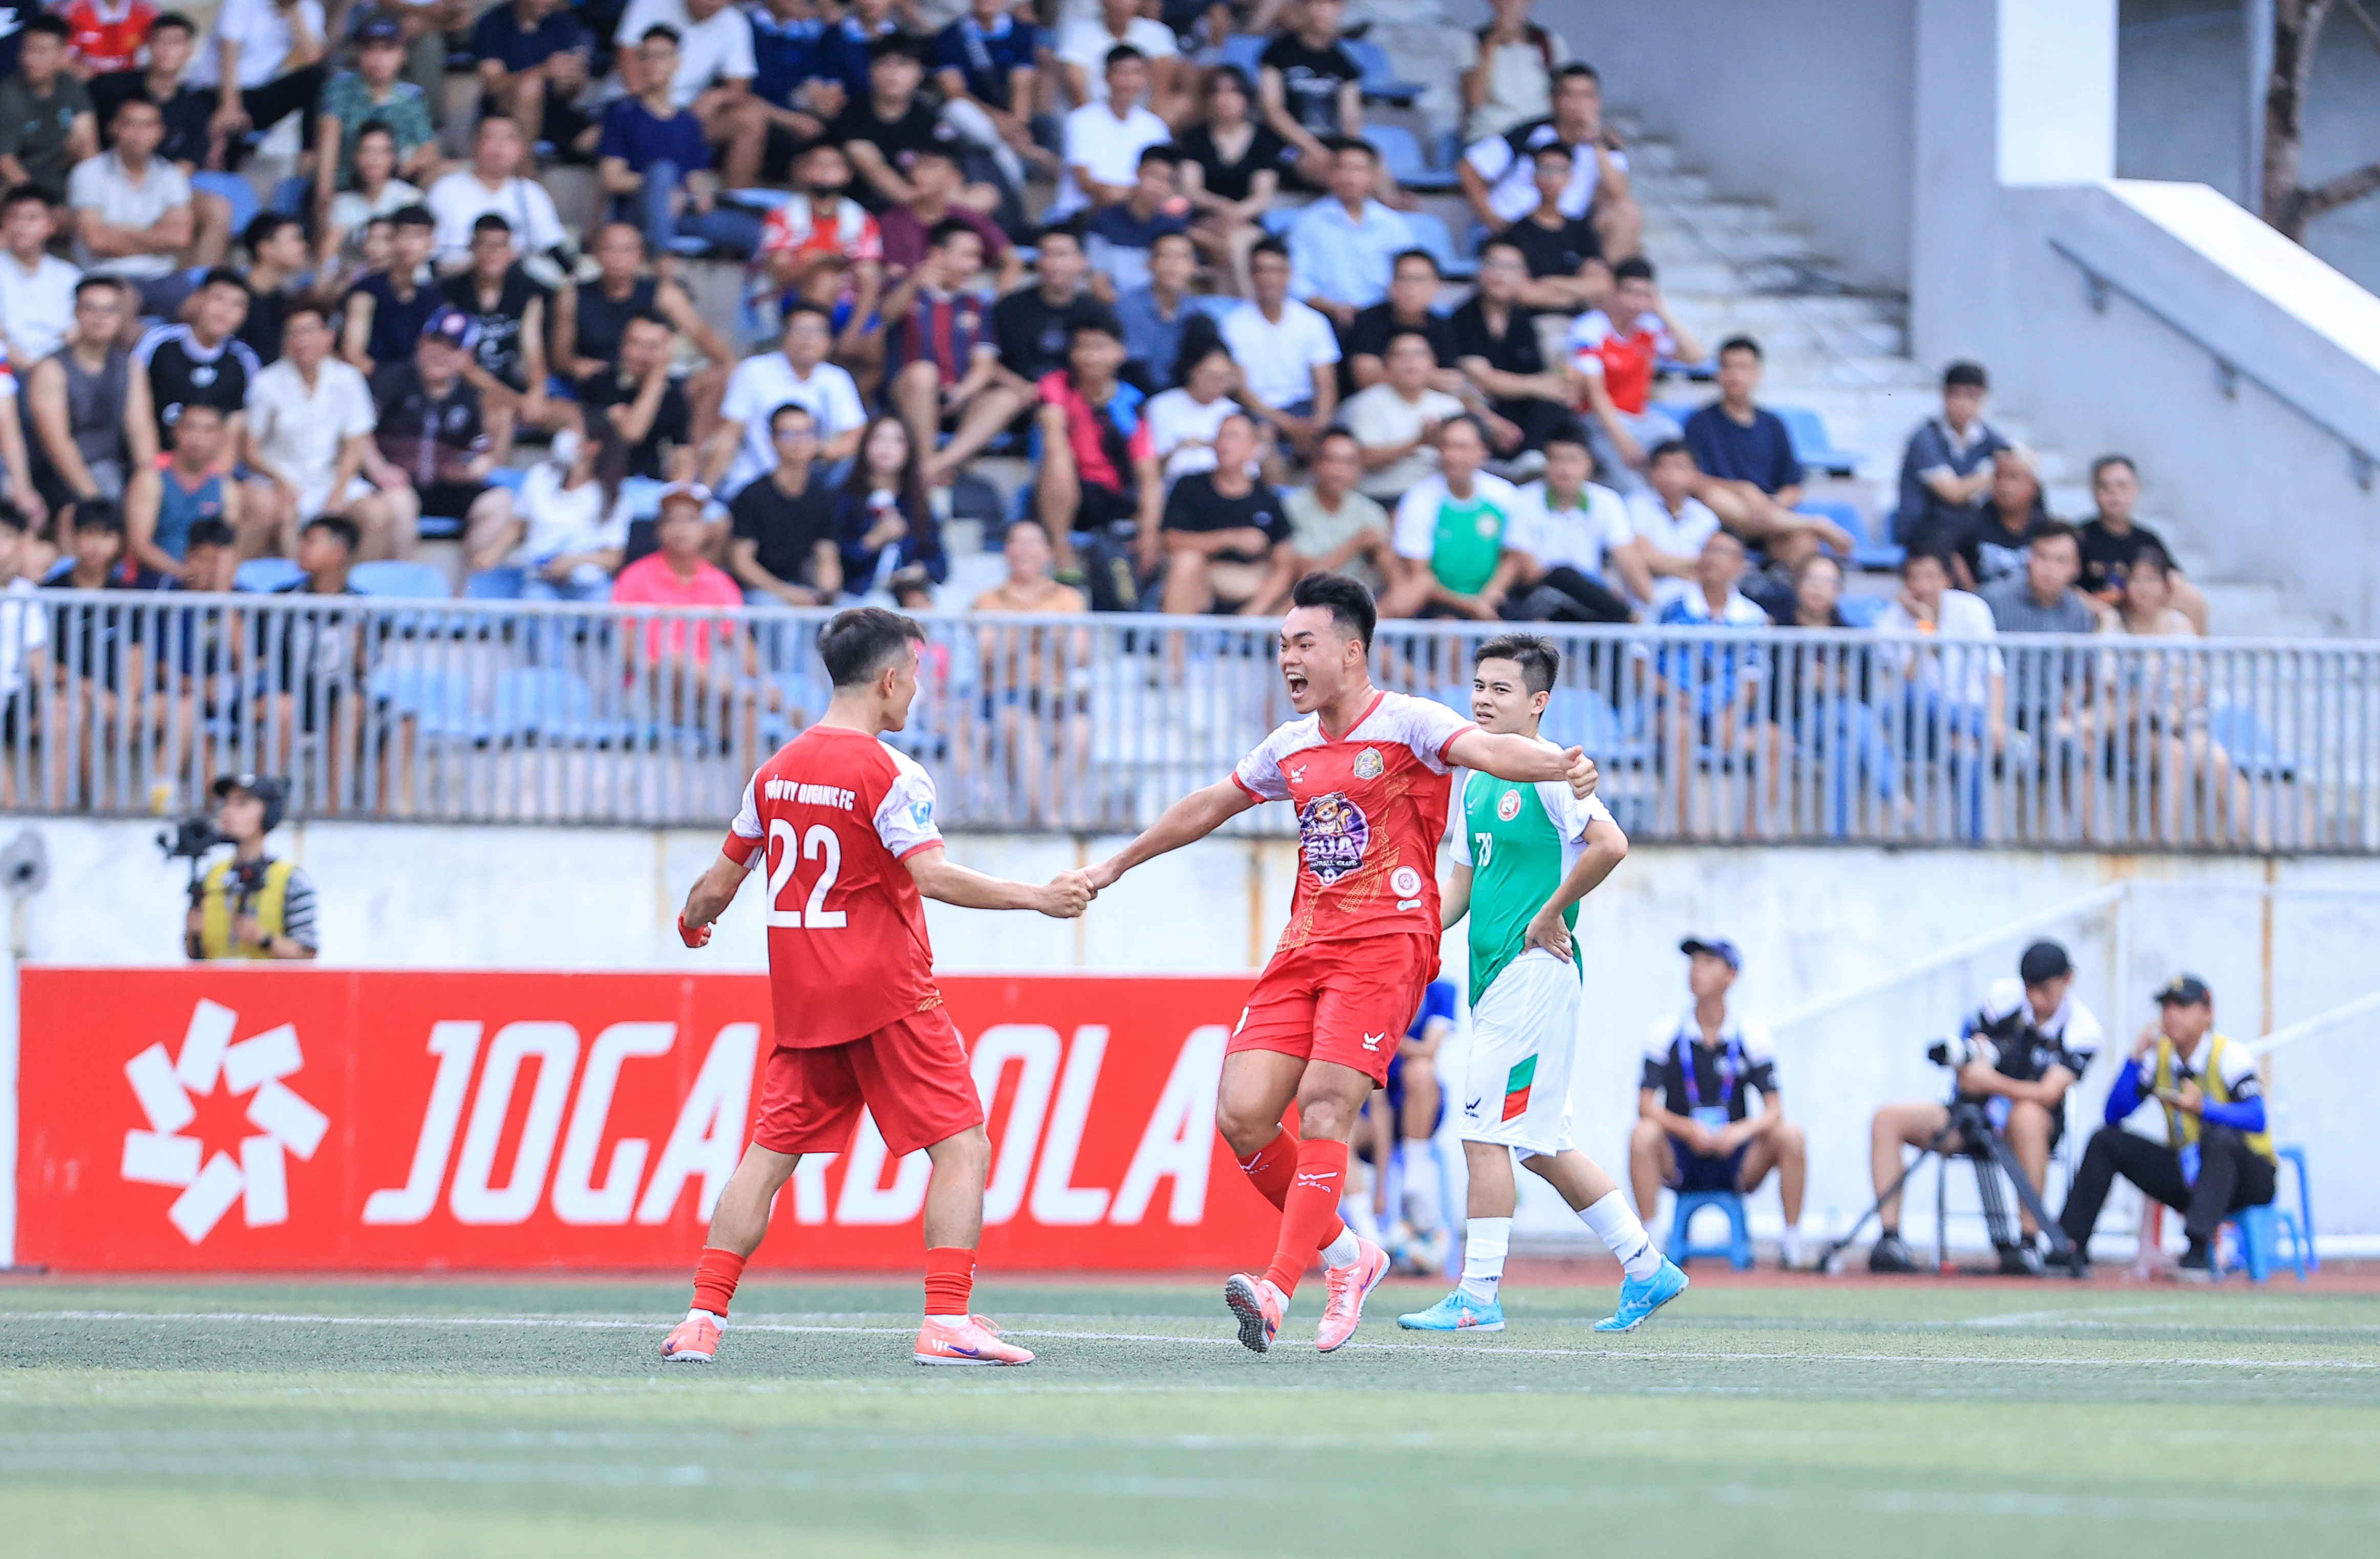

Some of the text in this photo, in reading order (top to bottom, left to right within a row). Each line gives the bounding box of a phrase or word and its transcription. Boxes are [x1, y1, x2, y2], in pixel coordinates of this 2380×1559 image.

[838, 789, 855, 810] FC
[766, 818, 847, 929] 22
[362, 1020, 1231, 1226] JOGAOLA
